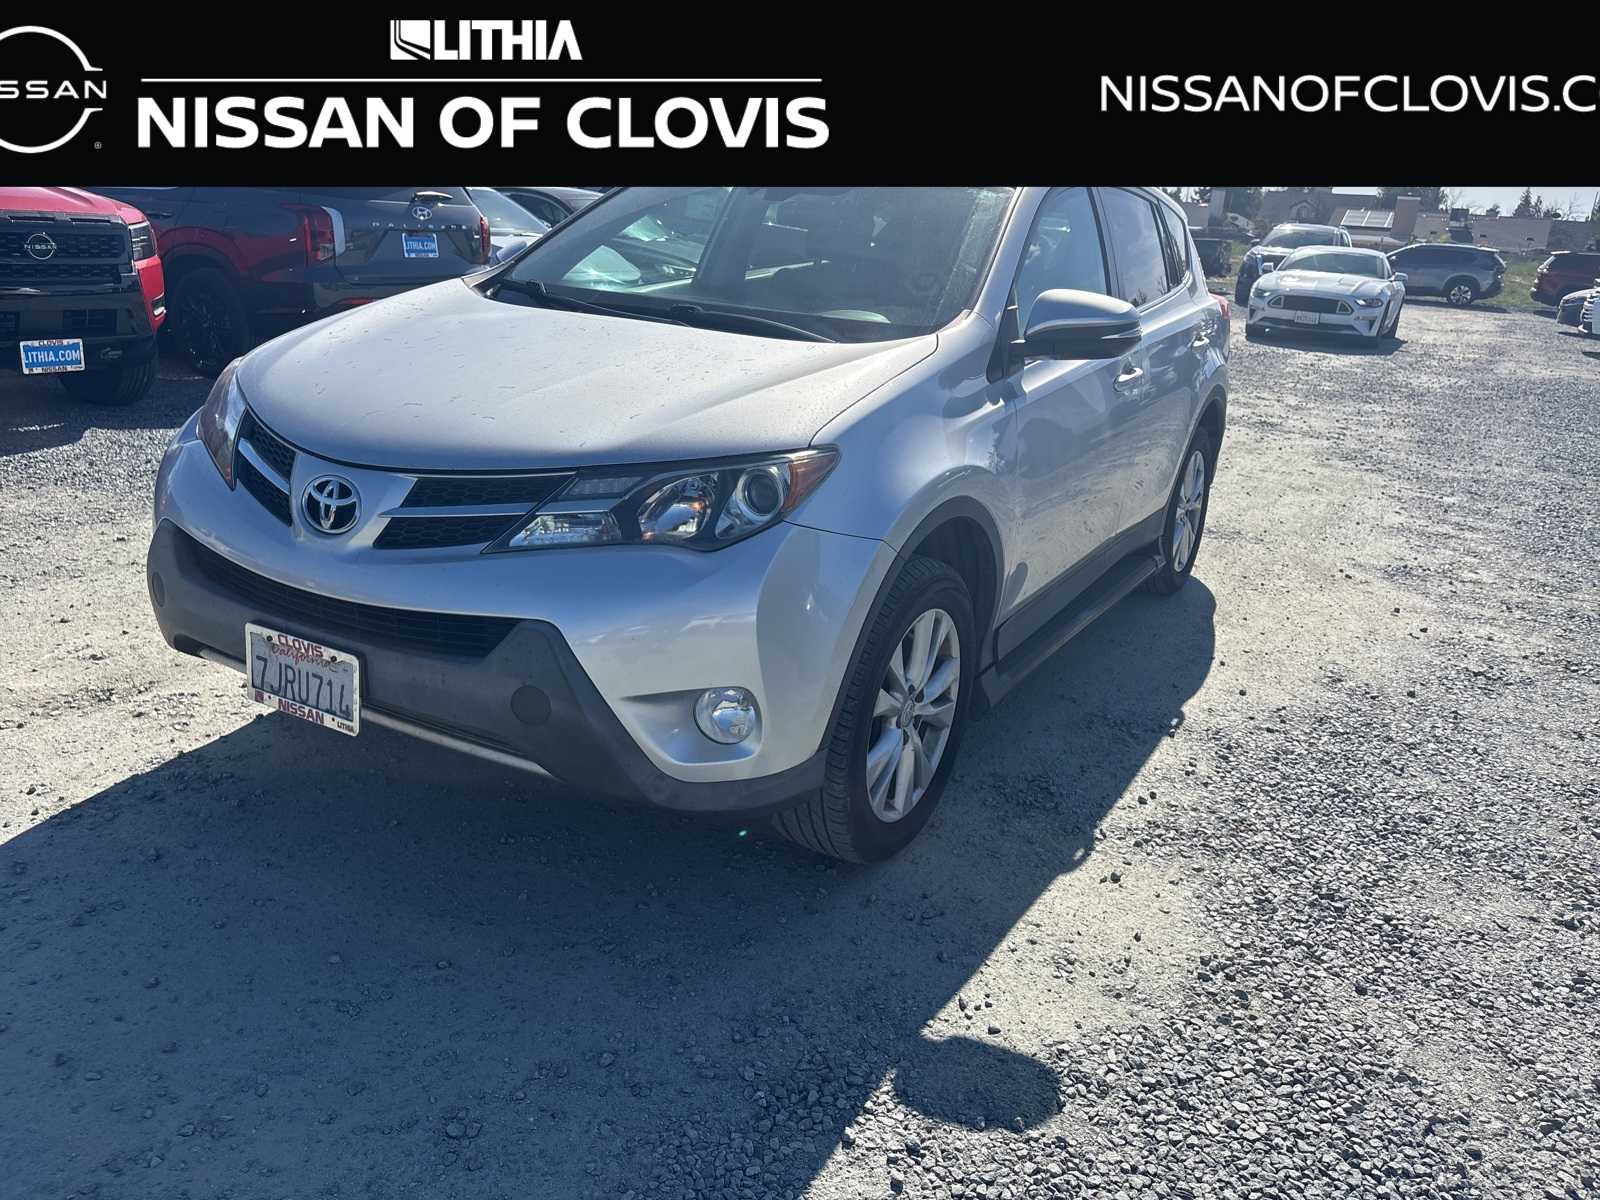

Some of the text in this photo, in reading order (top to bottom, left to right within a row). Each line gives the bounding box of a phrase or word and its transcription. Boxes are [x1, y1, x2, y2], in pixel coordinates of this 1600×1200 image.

[23, 350, 80, 363] LITHIA.COM
[278, 633, 323, 658] CLOVIS
[255, 655, 350, 719] 7JRU714
[278, 698, 325, 724] NISSAN
